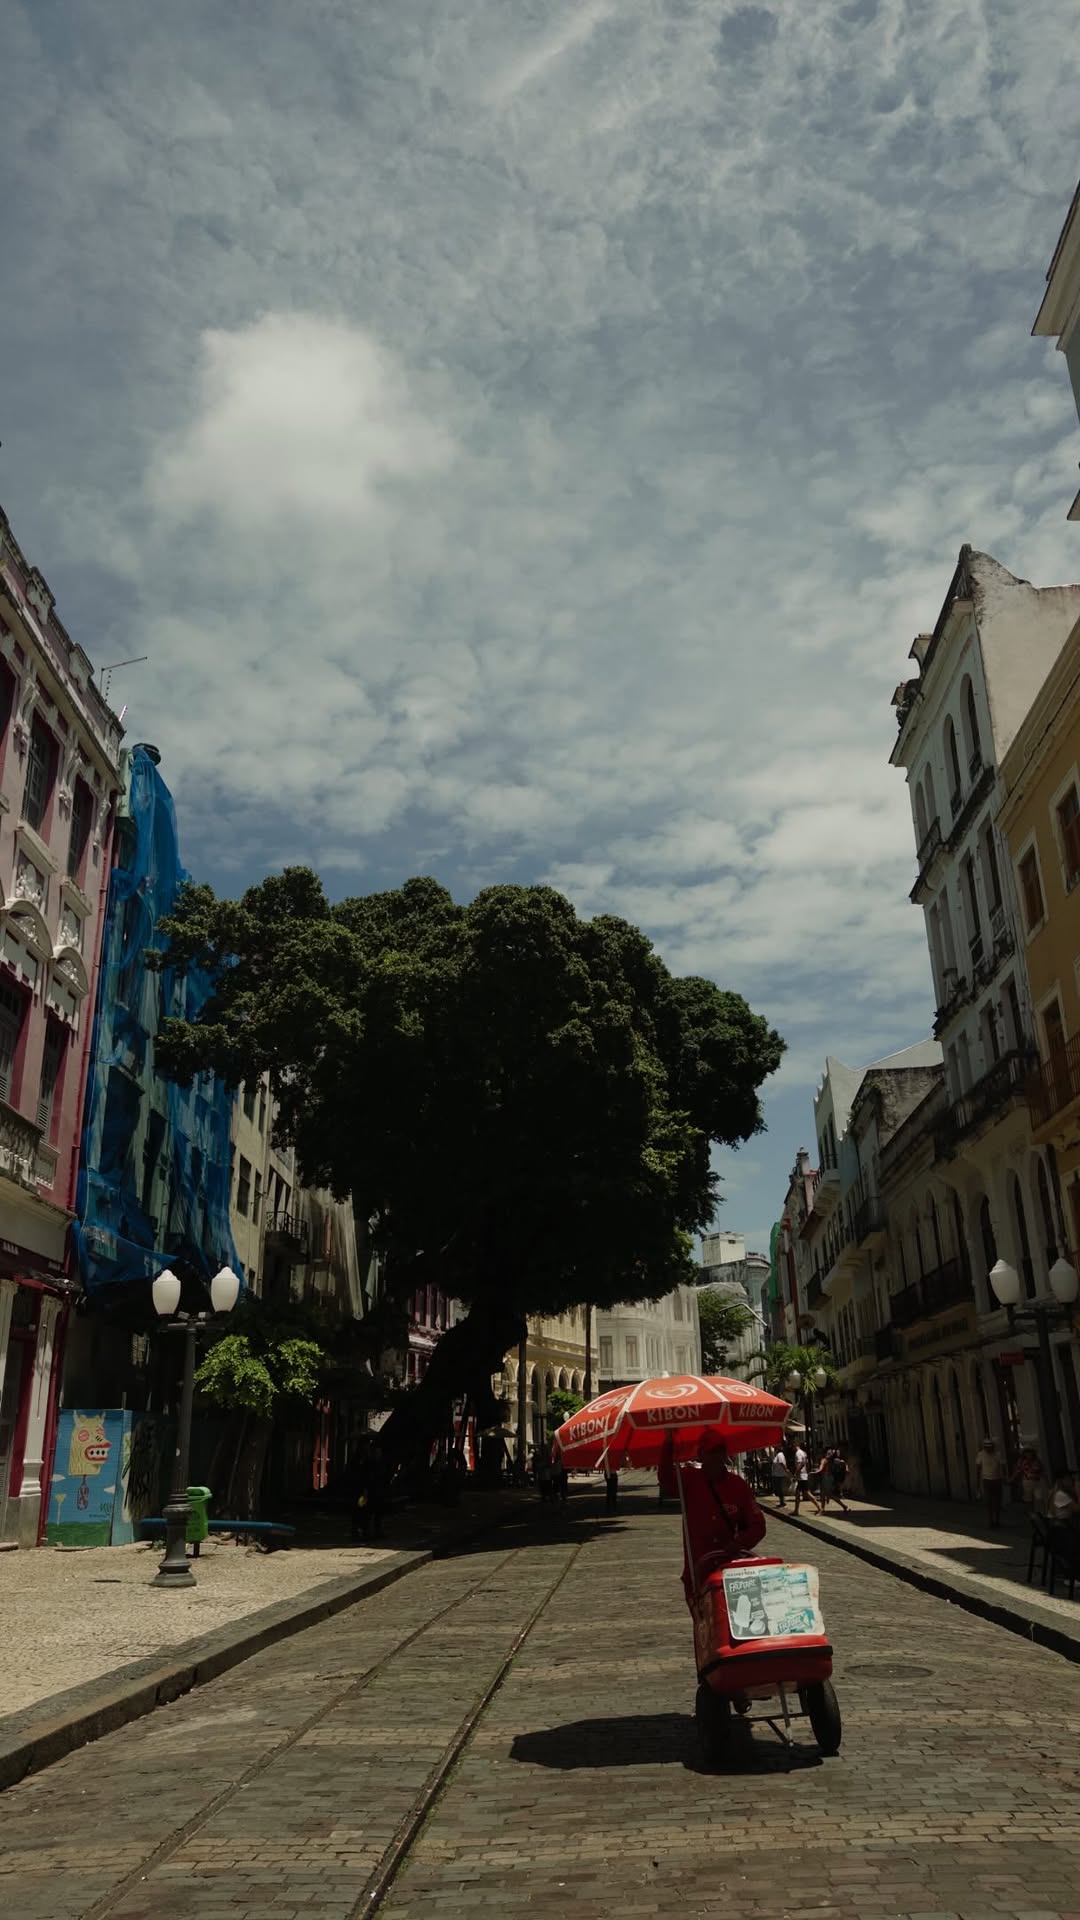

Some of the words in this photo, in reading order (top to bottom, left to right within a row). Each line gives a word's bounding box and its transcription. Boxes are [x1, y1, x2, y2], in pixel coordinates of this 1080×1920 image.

[646, 1405, 699, 1423] KIBON
[738, 1404, 774, 1417] KIBON
[569, 1416, 604, 1440] KIBON
